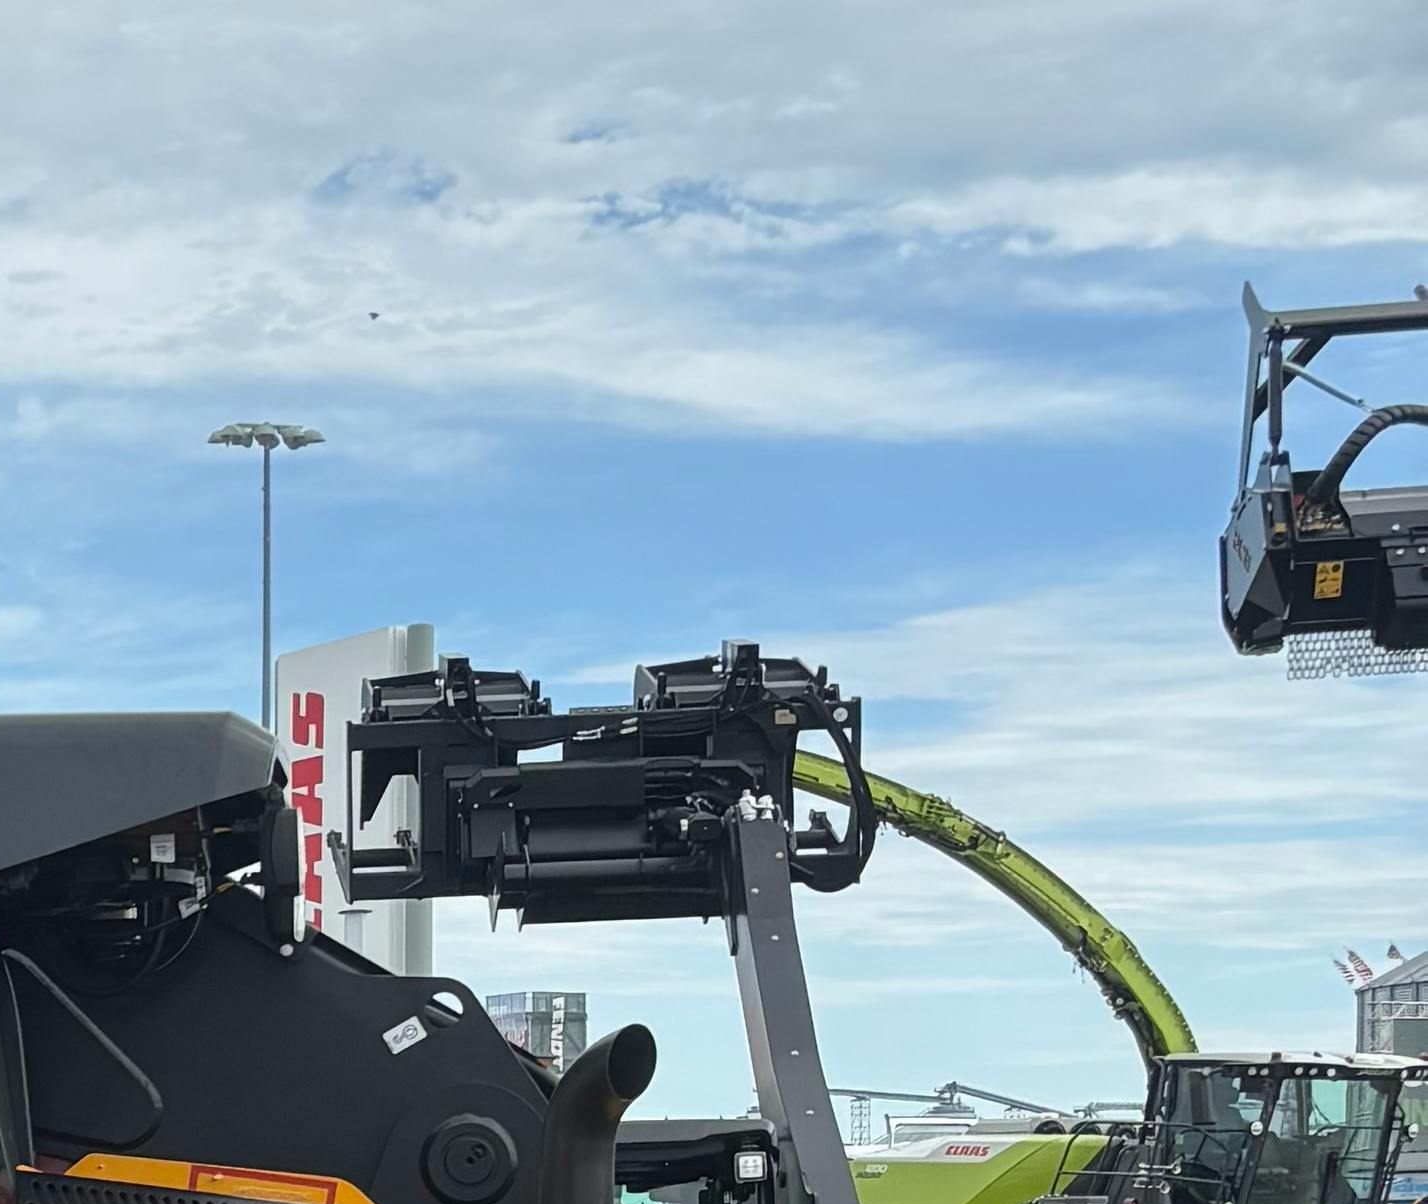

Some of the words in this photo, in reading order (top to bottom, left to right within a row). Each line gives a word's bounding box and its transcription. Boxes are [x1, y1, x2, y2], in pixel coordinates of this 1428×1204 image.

[291, 691, 325, 933] AAS
[551, 996, 565, 1073] FENDT
[945, 1145, 991, 1157] CLAAS
